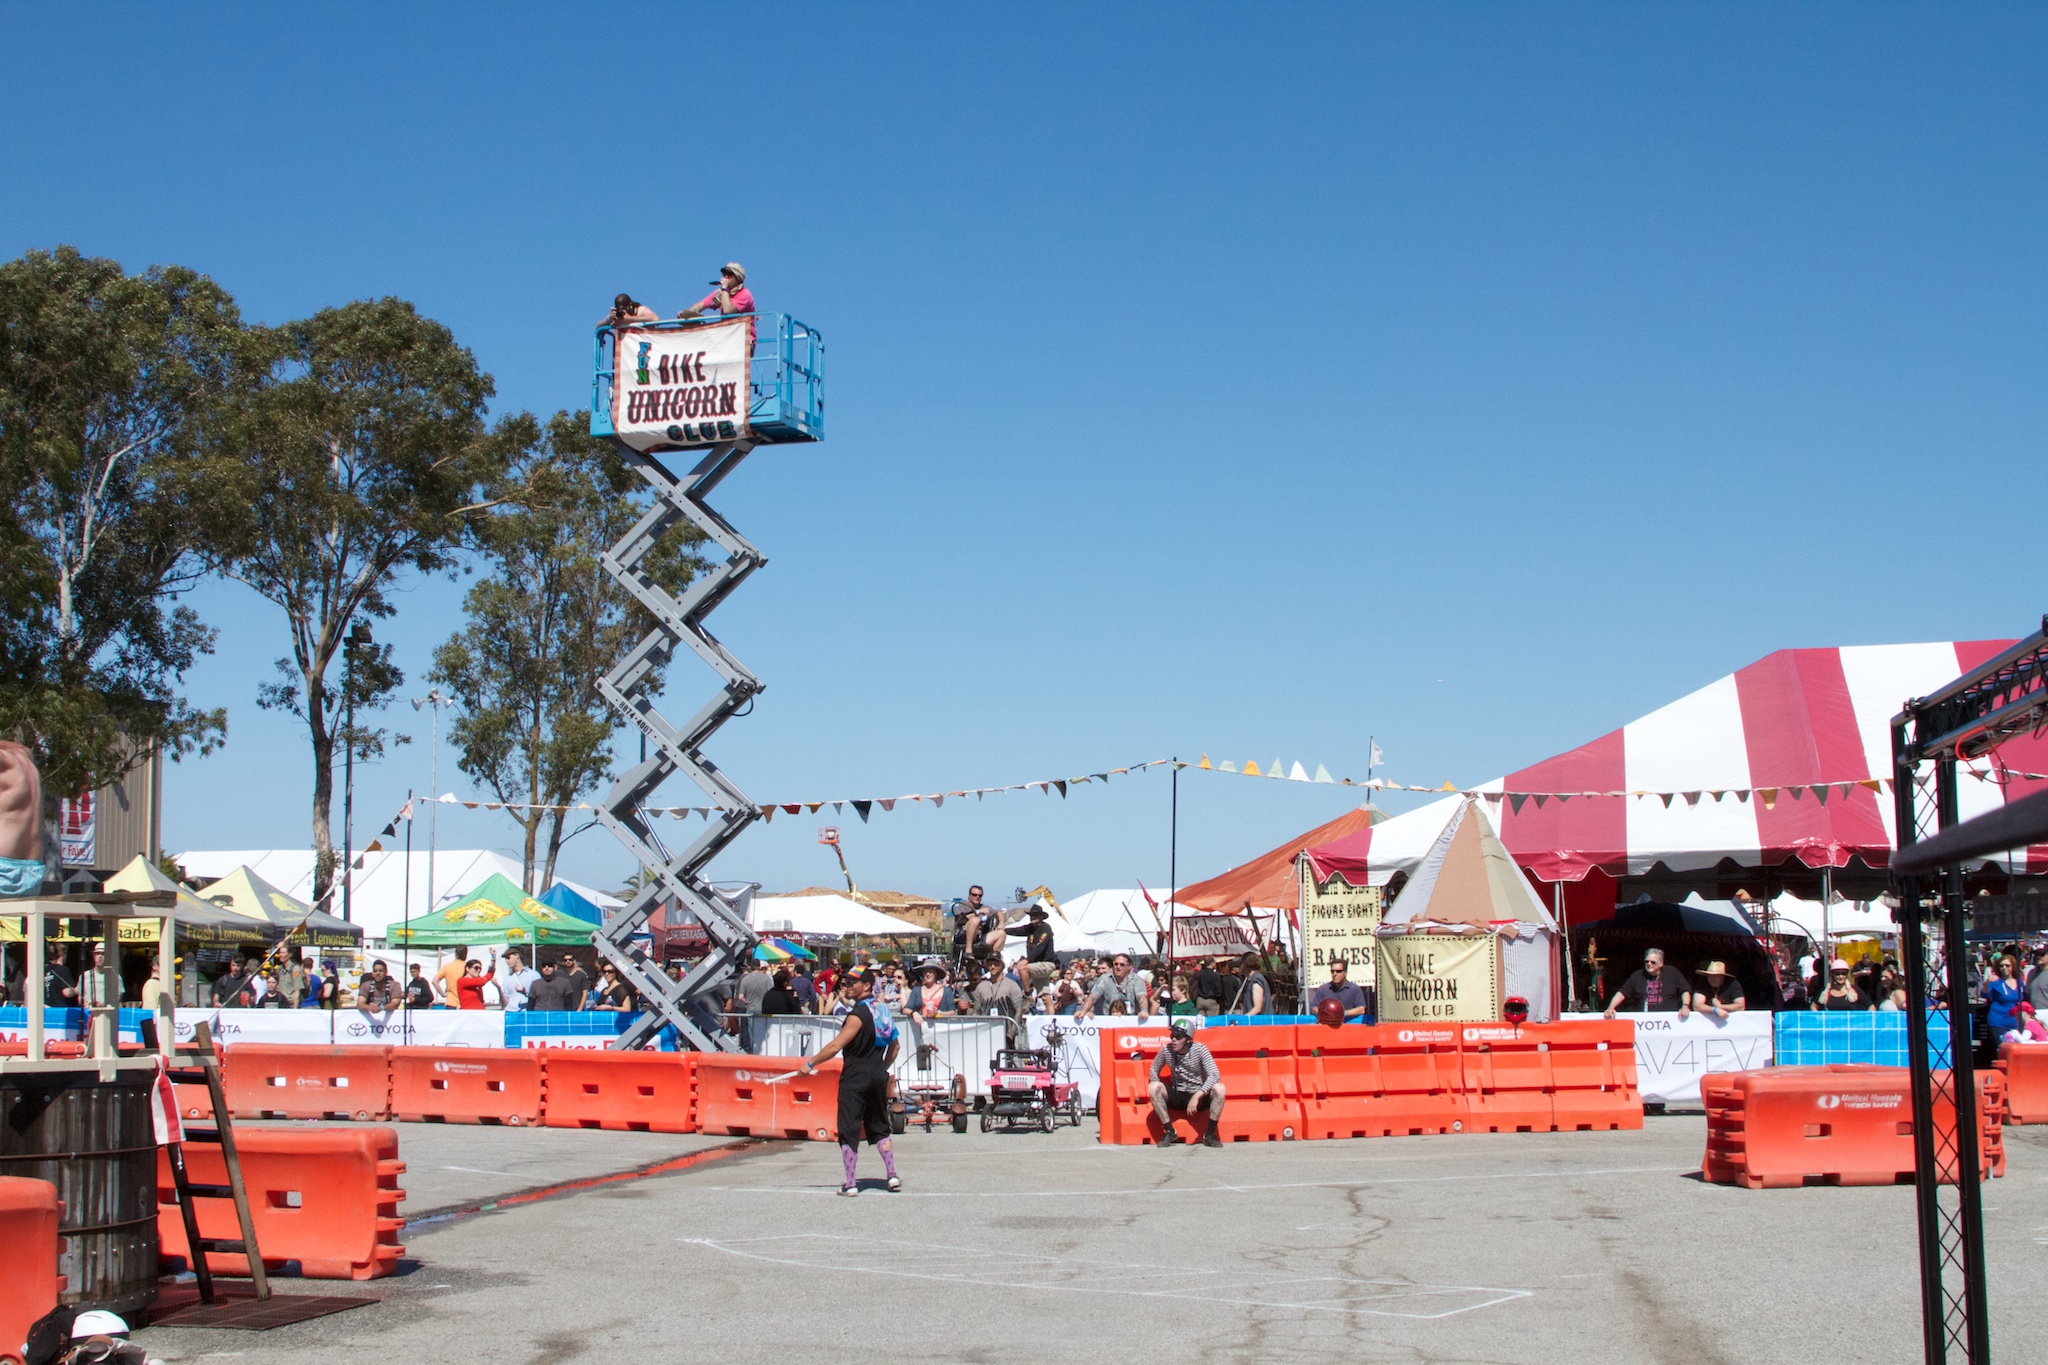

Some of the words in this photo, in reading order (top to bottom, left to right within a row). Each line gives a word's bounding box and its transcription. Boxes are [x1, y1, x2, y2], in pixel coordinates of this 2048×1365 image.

[637, 341, 651, 385] FUN
[658, 351, 707, 385] BIKE
[627, 381, 738, 424] UNICORN
[667, 420, 737, 442] CLUB
[1312, 904, 1344, 919] FIGURE
[1347, 903, 1374, 919] EIGHT
[186, 923, 215, 940] Fresh
[217, 924, 264, 941] Lemonade
[313, 929, 355, 946] Lemonade
[1315, 929, 1347, 937] PEDAL
[1352, 928, 1372, 936] CAR
[1313, 947, 1375, 966] RACES!
[1406, 954, 1435, 975] BIKE
[1394, 978, 1458, 1001] UNICORN
[1412, 1004, 1455, 1017] CLUB
[368, 1024, 417, 1034] TOYOTA
[1636, 1021, 1672, 1031] YOTA
